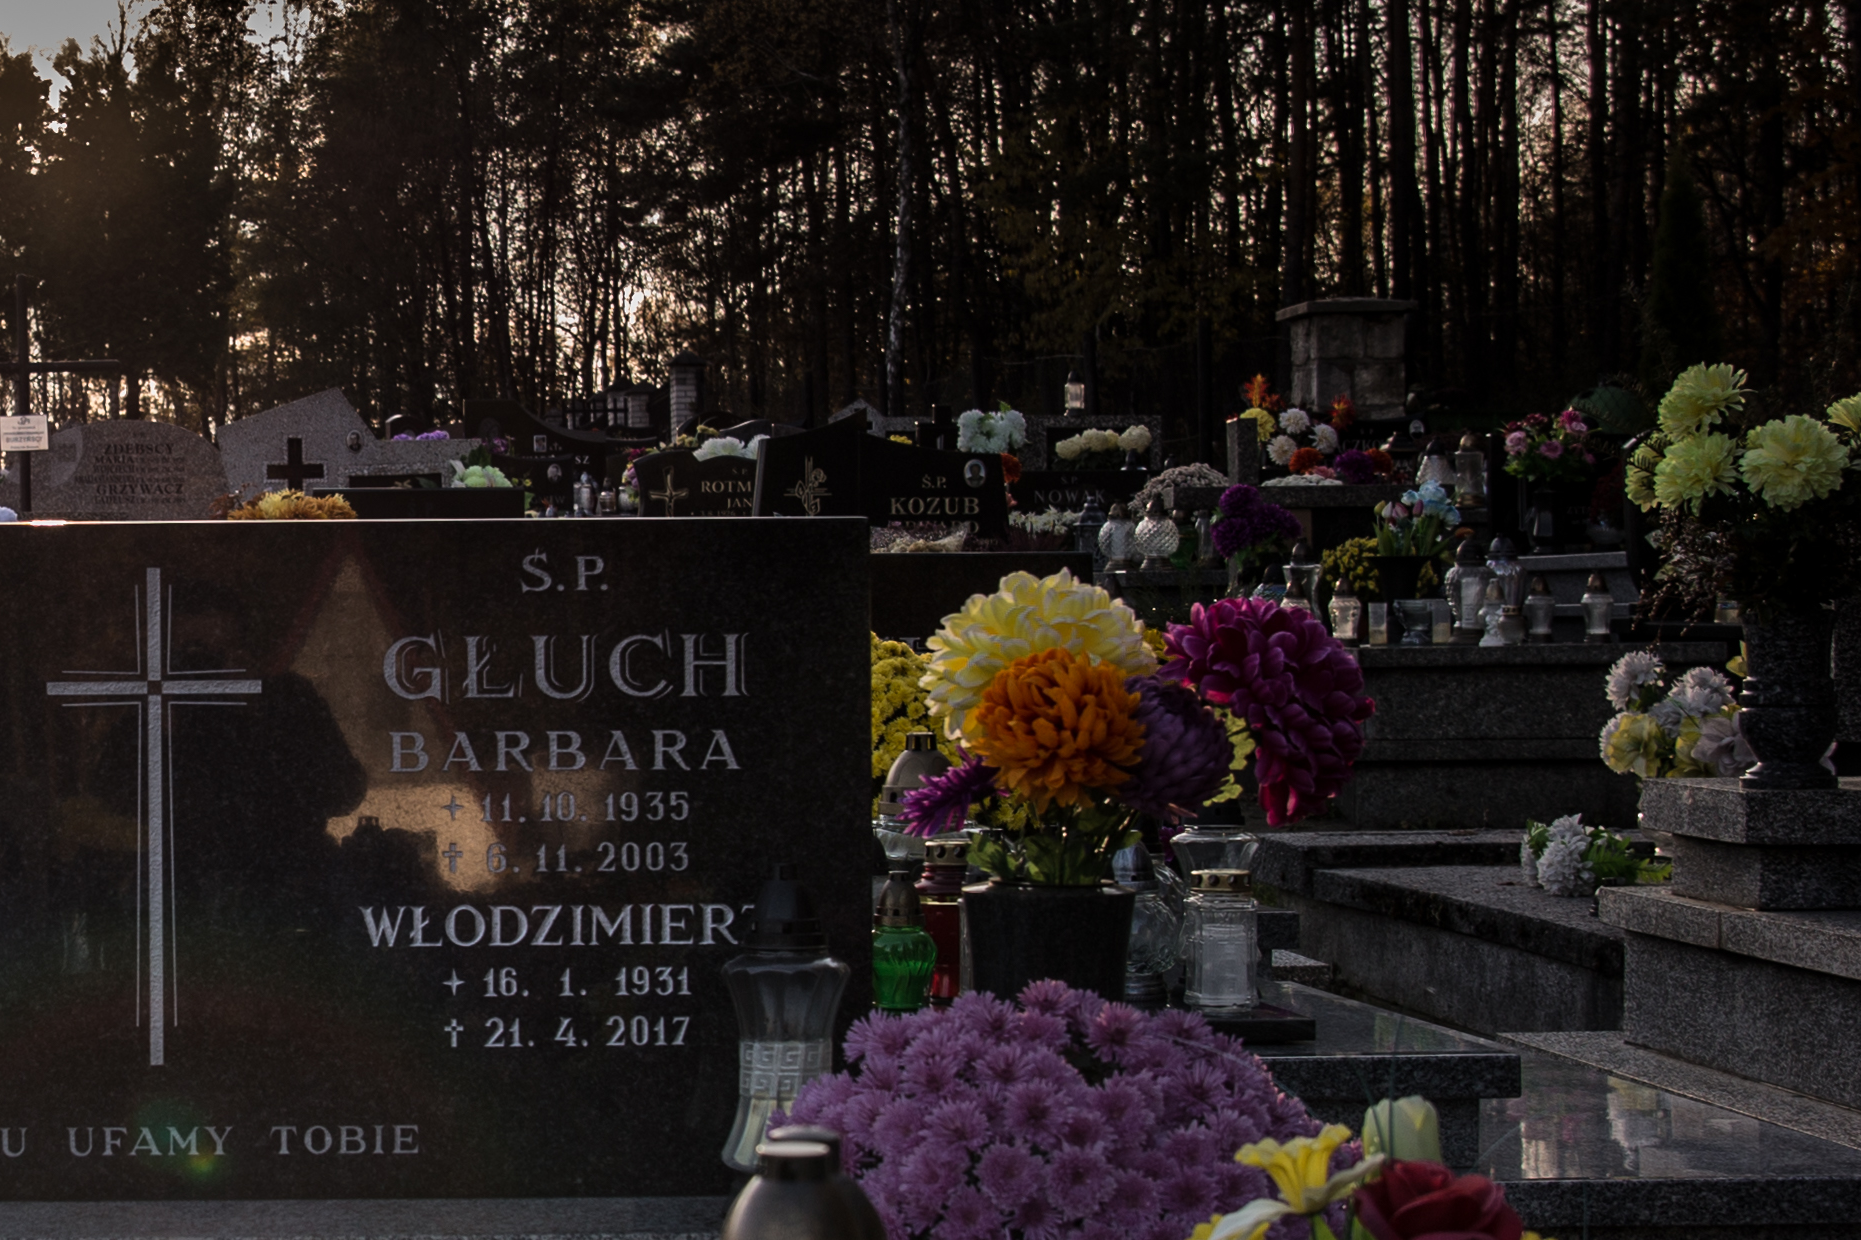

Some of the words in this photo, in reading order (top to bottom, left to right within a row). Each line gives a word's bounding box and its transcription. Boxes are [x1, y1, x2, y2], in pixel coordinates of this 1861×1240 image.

[921, 474, 947, 489] Ś.P.
[1034, 489, 1107, 504] NOWAK
[889, 497, 980, 515] KOZUB
[382, 630, 749, 702] GŁUCH
[389, 729, 741, 773] BARBARA
[605, 790, 690, 822] 1935
[596, 840, 689, 873] 2003
[360, 903, 755, 948] WŁODZIMIER
[483, 966, 530, 998] 16.
[559, 967, 587, 997] 1.
[615, 965, 692, 997] 1931
[484, 1016, 535, 1048] 21.
[553, 1017, 589, 1048] 4.
[605, 1014, 691, 1047] 2017
[67, 1126, 233, 1157] UFAMY
[270, 1124, 420, 1156] TOBIE
